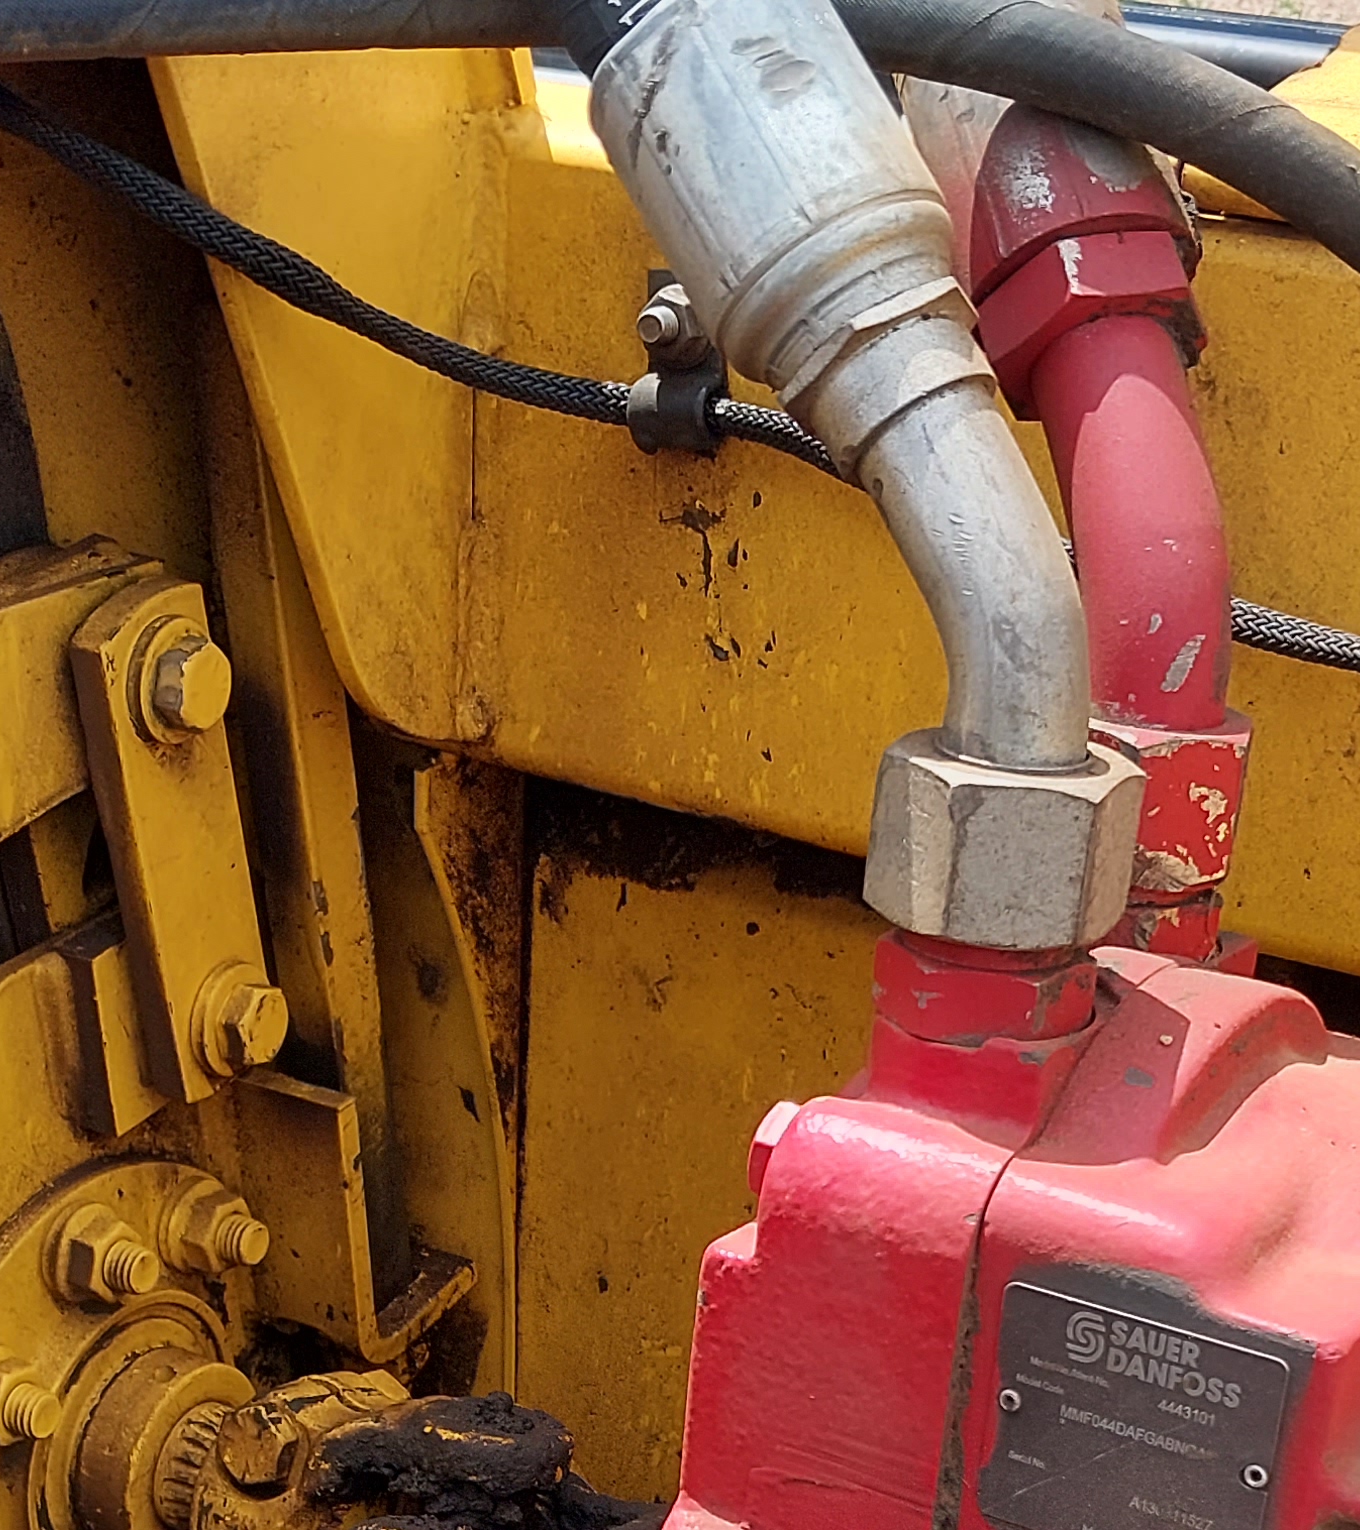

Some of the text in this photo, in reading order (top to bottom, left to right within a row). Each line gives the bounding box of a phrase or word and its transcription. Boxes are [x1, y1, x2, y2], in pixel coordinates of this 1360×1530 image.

[1109, 1320, 1201, 1368] SAUER
[1106, 1349, 1242, 1409] DANFOSS
[1157, 1399, 1216, 1427] 4443101
